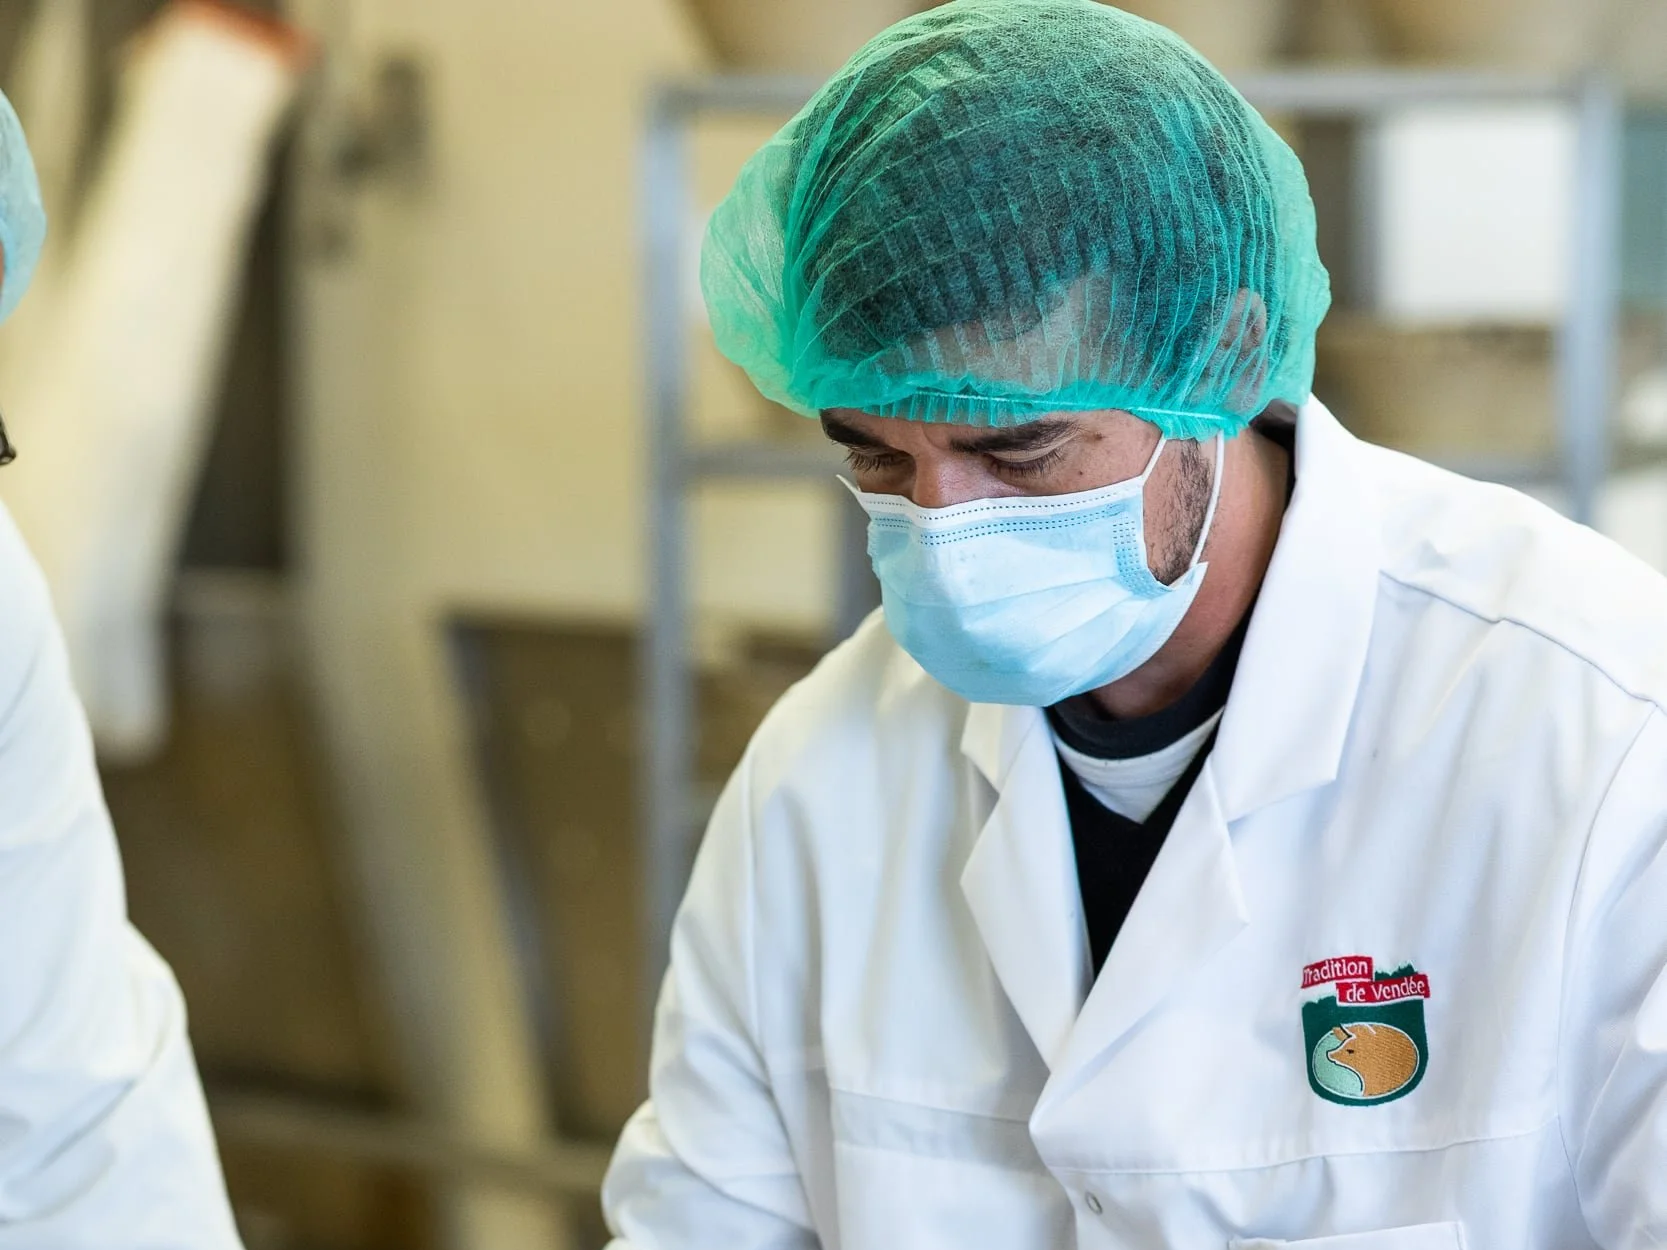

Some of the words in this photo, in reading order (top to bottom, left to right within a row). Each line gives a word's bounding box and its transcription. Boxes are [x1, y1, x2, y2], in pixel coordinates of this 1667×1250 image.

[1303, 959, 1369, 985] Tradition
[1346, 983, 1366, 1002] de
[1371, 976, 1425, 1000] Vendée
